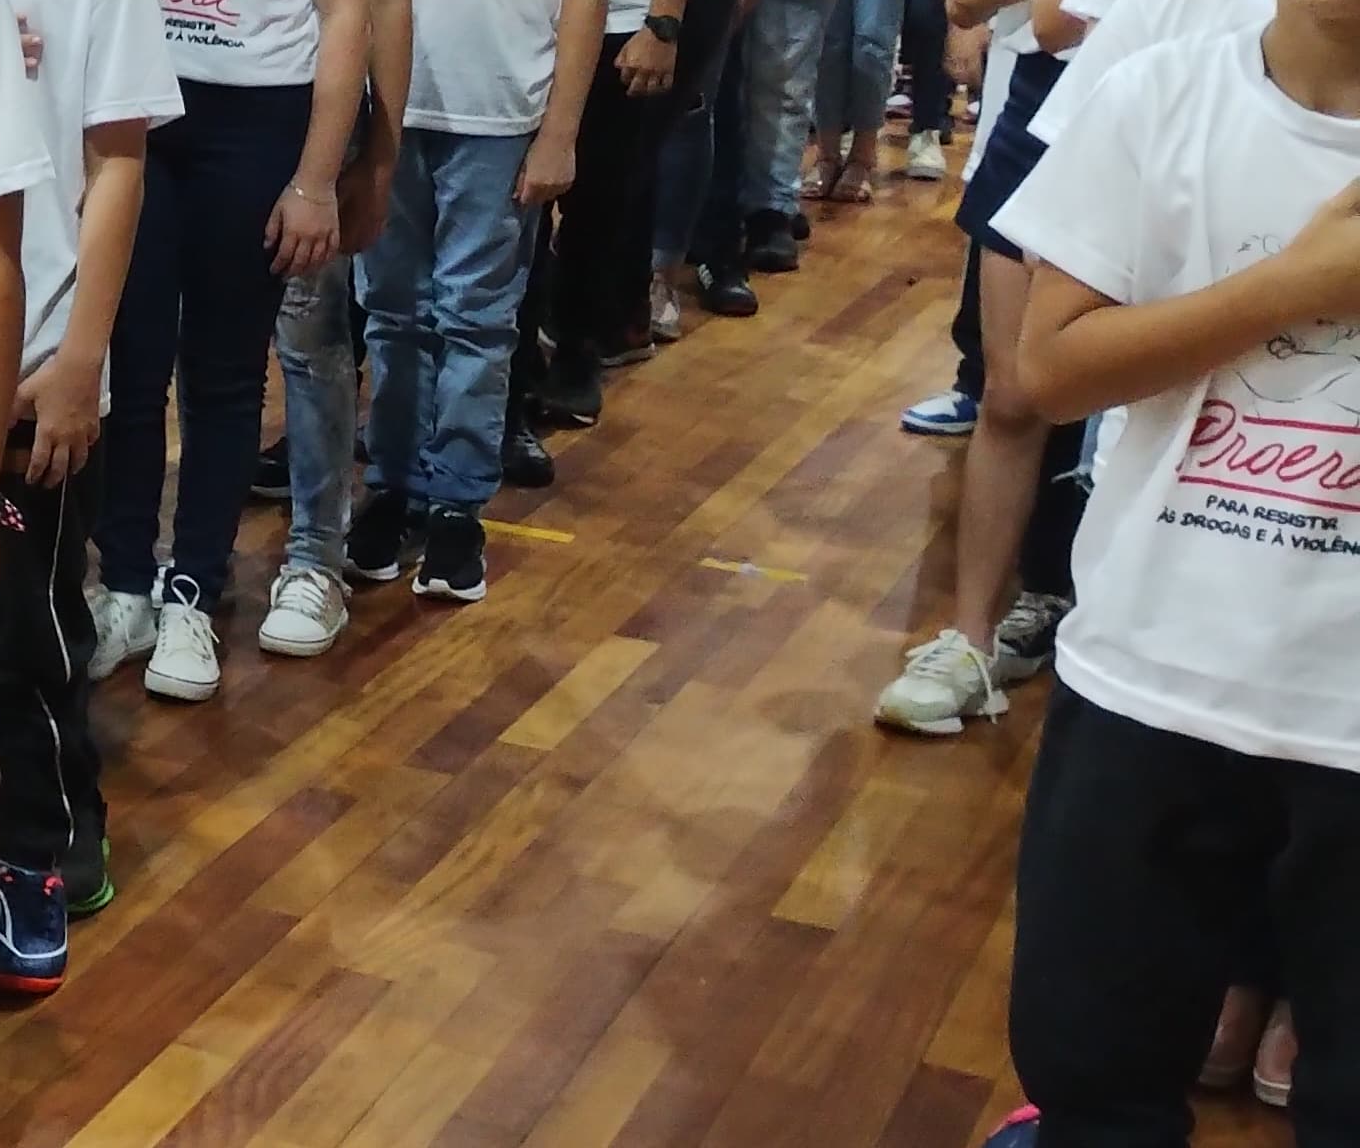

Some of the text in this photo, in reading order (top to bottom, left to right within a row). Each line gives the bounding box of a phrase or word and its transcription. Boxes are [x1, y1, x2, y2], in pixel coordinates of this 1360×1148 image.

[1156, 505, 1177, 525] ÀS
[1180, 511, 1252, 540] DROGAS
[1255, 528, 1268, 542] E
[1271, 527, 1285, 547] À
[1205, 494, 1340, 531] PARA RESISTIR
